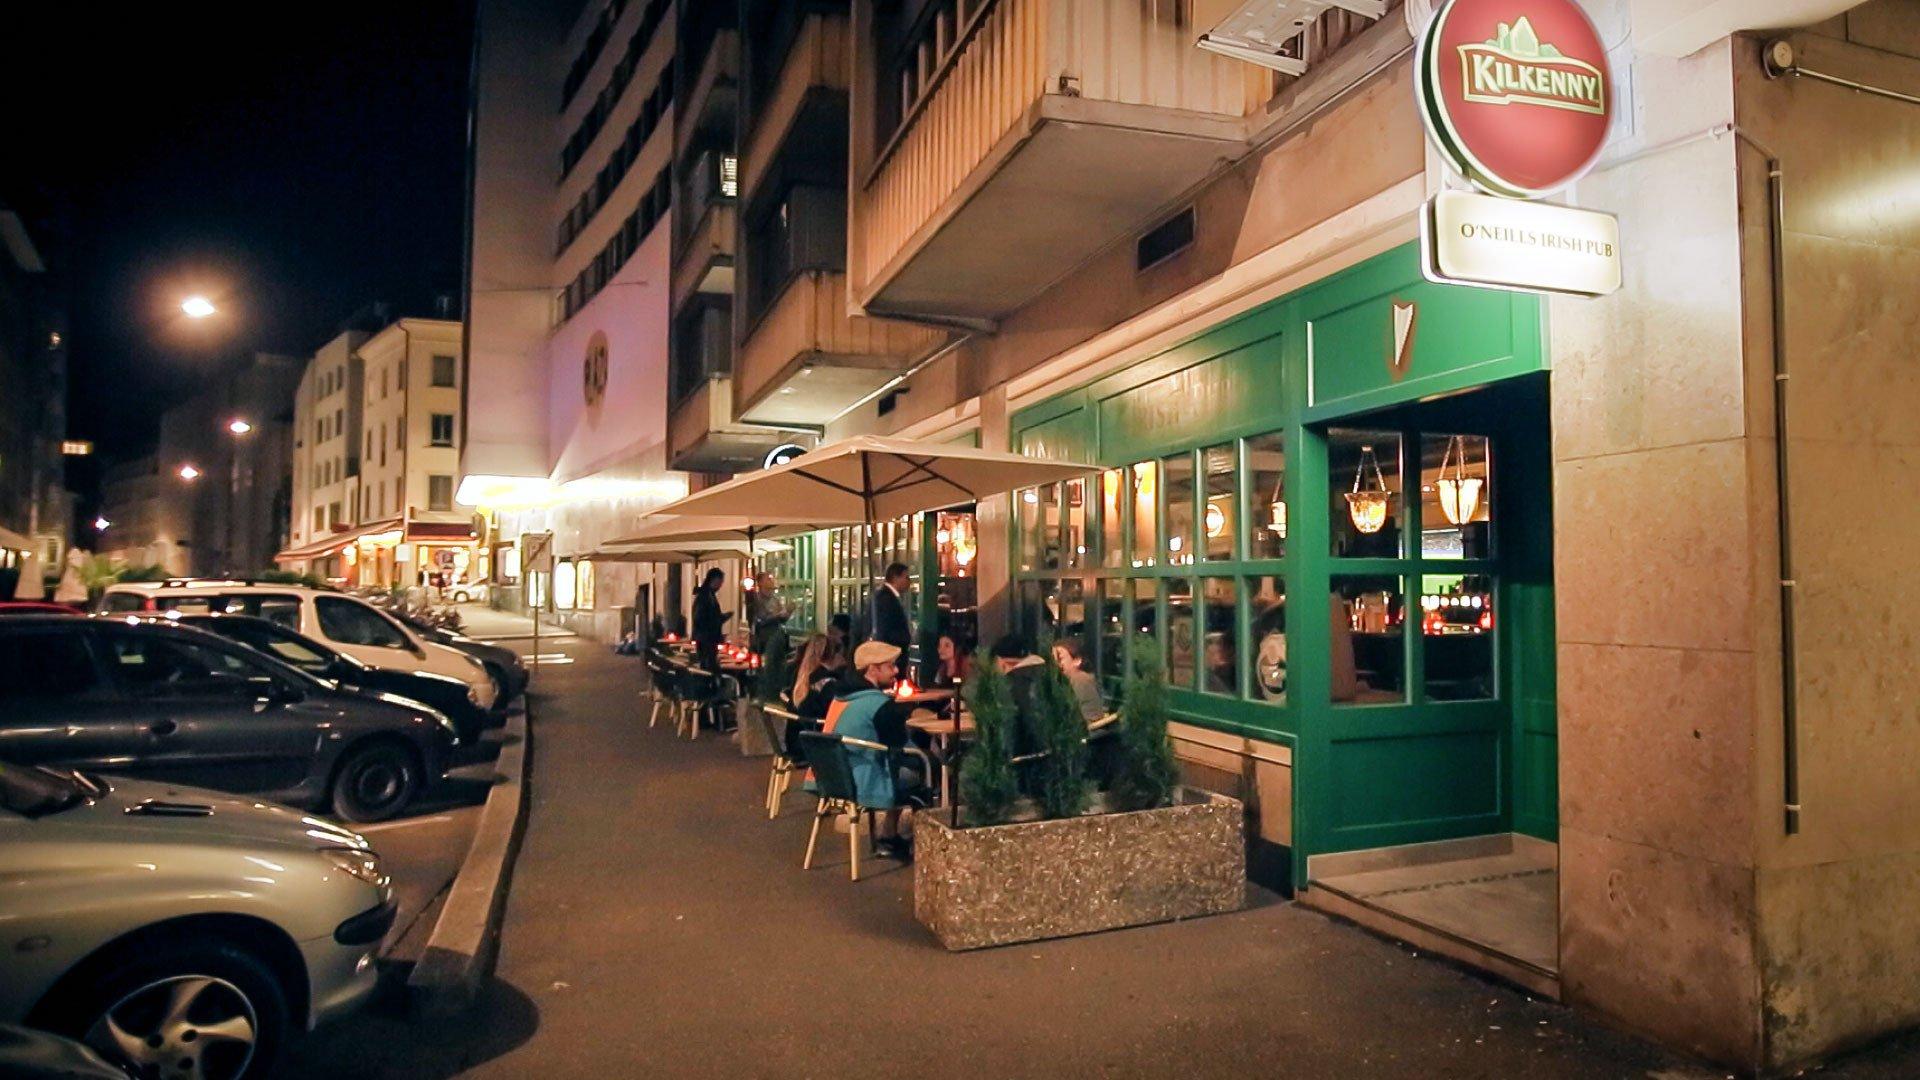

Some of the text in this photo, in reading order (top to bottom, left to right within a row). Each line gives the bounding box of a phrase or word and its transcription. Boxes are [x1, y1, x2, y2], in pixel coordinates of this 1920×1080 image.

[1472, 53, 1596, 101] KILKENNY
[1461, 223, 1613, 257] O'NEILLS IRISH PUB
